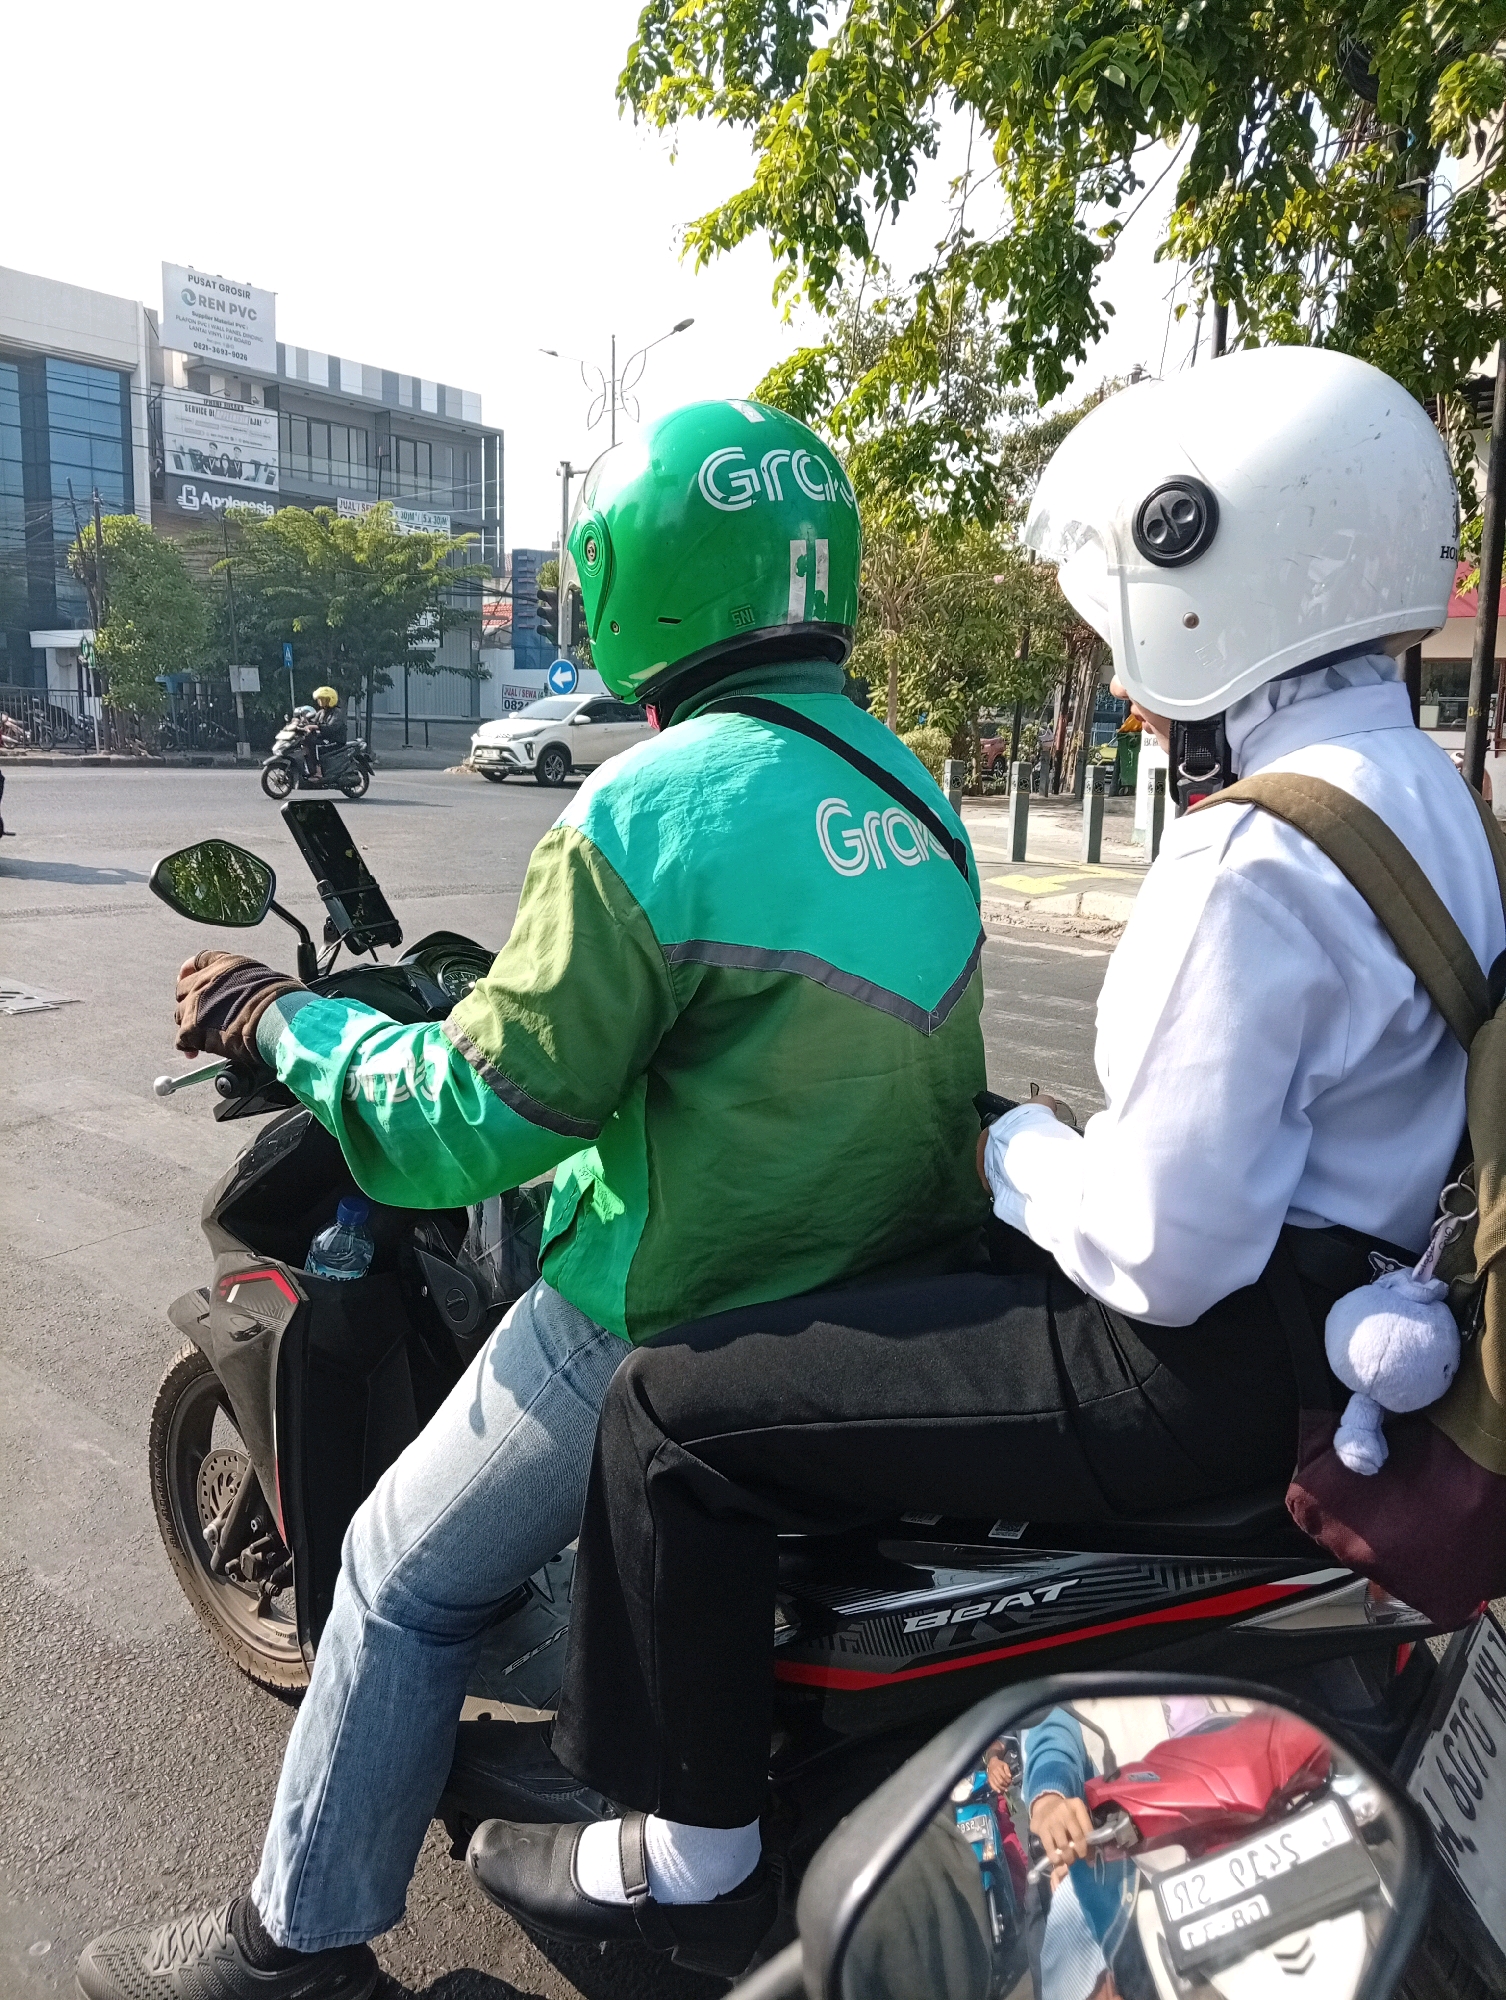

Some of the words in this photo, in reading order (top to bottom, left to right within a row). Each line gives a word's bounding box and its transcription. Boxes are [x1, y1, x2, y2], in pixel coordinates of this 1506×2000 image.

[188, 274, 216, 290] PUSAT
[219, 283, 251, 299] GROSIR
[198, 294, 226, 313] REN
[229, 302, 257, 321] PVC
[191, 311, 213, 321] Supplier
[184, 404, 207, 416] SERVICE
[208, 408, 215, 417] DI
[339, 500, 356, 511] JUAL
[732, 608, 754, 627] SNI
[521, 689, 536, 699] SEWA
